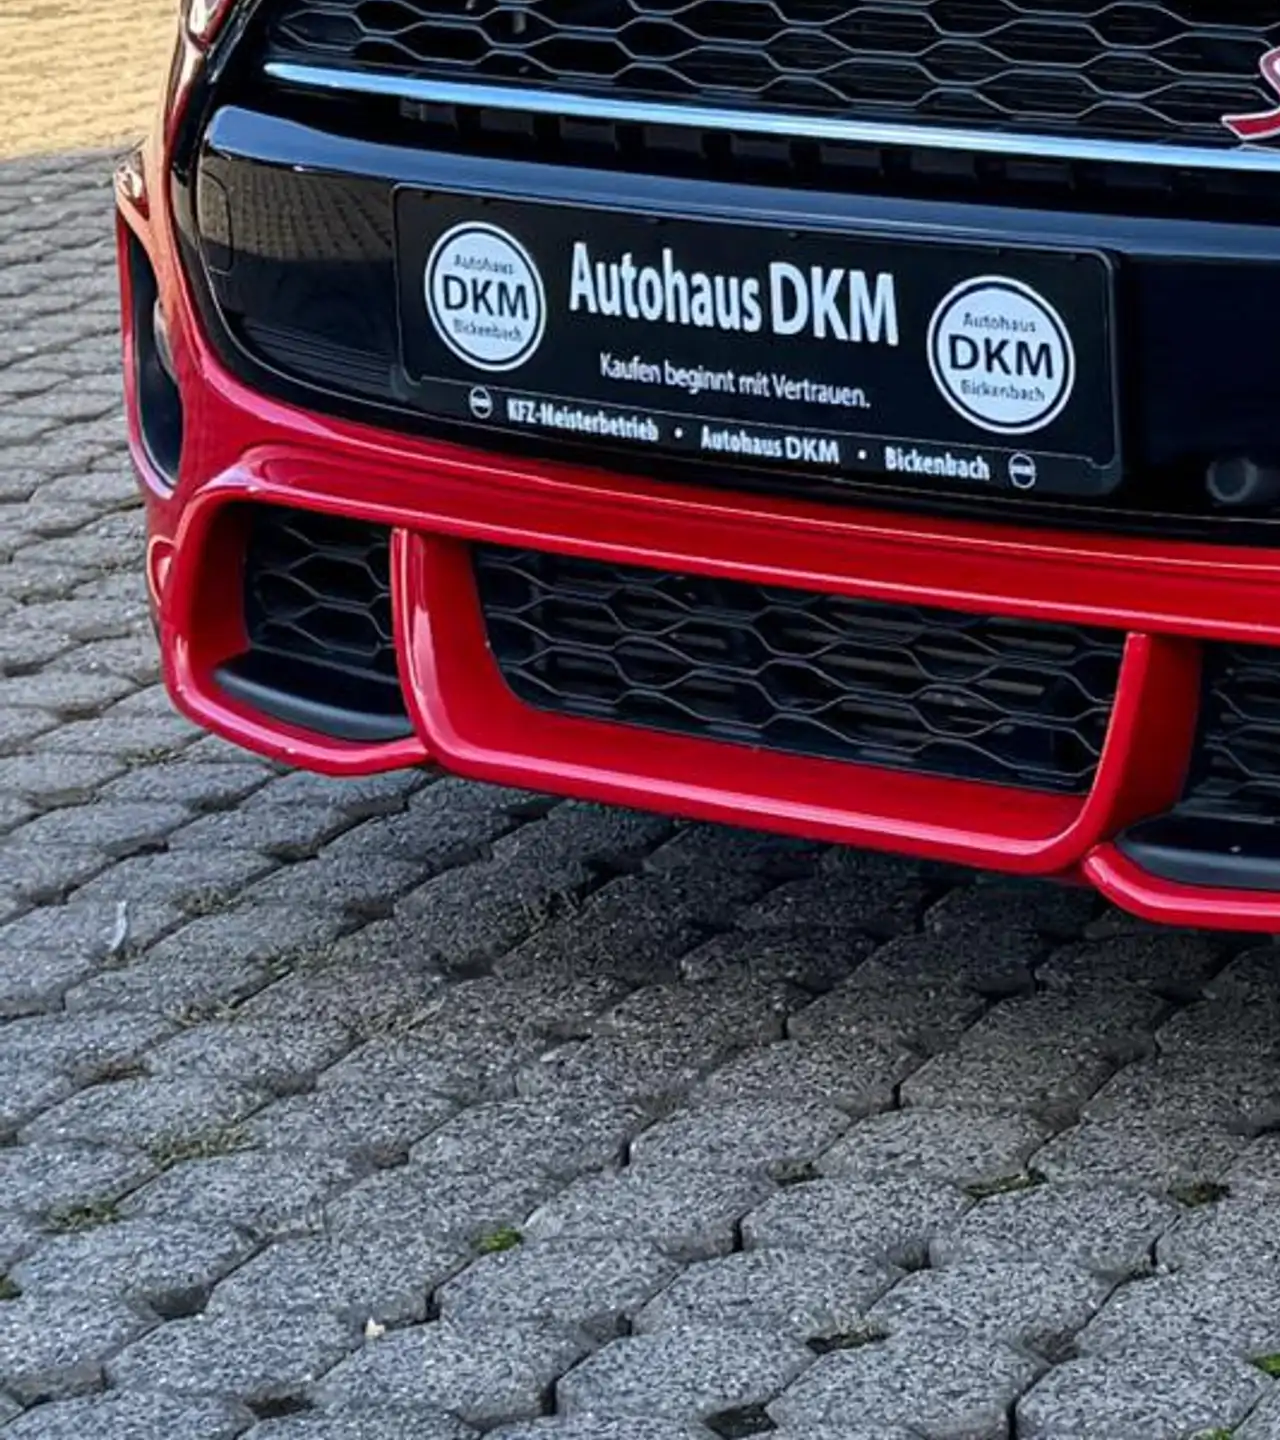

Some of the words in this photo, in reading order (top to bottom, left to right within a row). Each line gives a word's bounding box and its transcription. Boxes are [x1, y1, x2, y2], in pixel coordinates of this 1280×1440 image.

[442, 273, 530, 322] DKM
[569, 241, 763, 333] Autohaus
[769, 260, 900, 347] DKM
[962, 311, 1037, 333] Autohaus
[600, 352, 661, 385] Kaufen
[664, 360, 736, 396] beginnt
[739, 371, 770, 398] mit
[771, 373, 872, 409] Vertrauen.
[948, 332, 1054, 381] DKM
[960, 378, 1046, 403] Bickenbach
[506, 397, 660, 442] KFZ-Meisterbetrieb
[700, 424, 782, 459] Autohaus
[783, 435, 841, 465] DKM
[884, 446, 991, 481] Bickenbach
